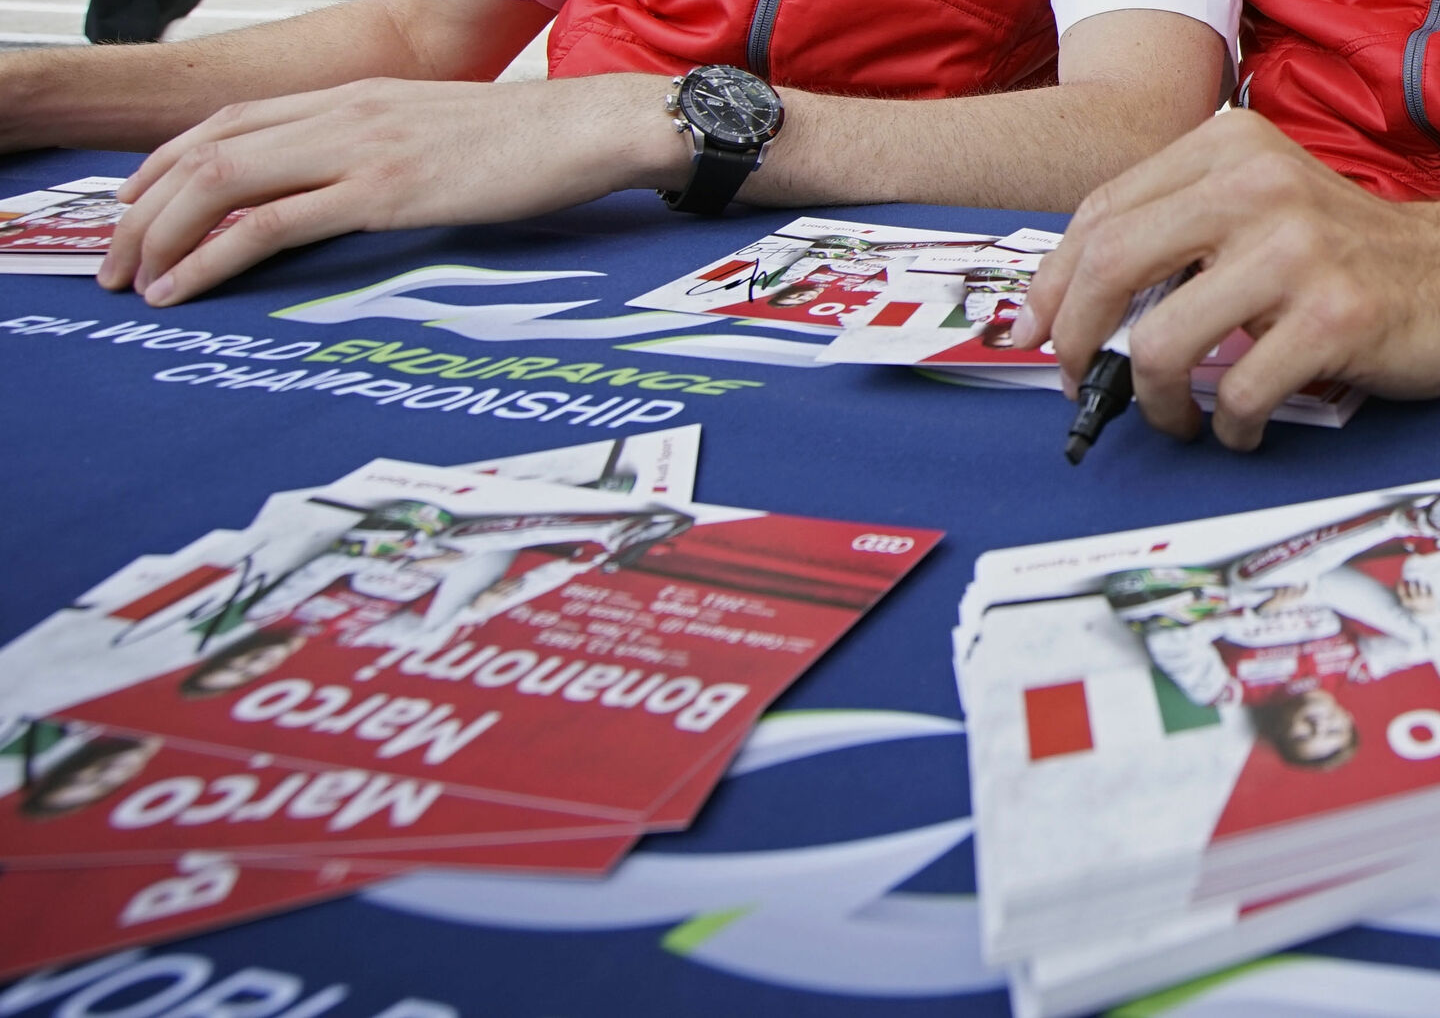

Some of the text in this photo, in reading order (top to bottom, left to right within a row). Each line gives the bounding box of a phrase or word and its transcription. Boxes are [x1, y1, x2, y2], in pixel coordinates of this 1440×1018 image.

[0, 315, 766, 396] FIA WORLD ENDURANCE
[153, 361, 686, 429] CHAMPIONSHIP
[231, 678, 500, 766] Marco
[352, 640, 750, 733] Bonanomi
[108, 769, 444, 832] Marco
